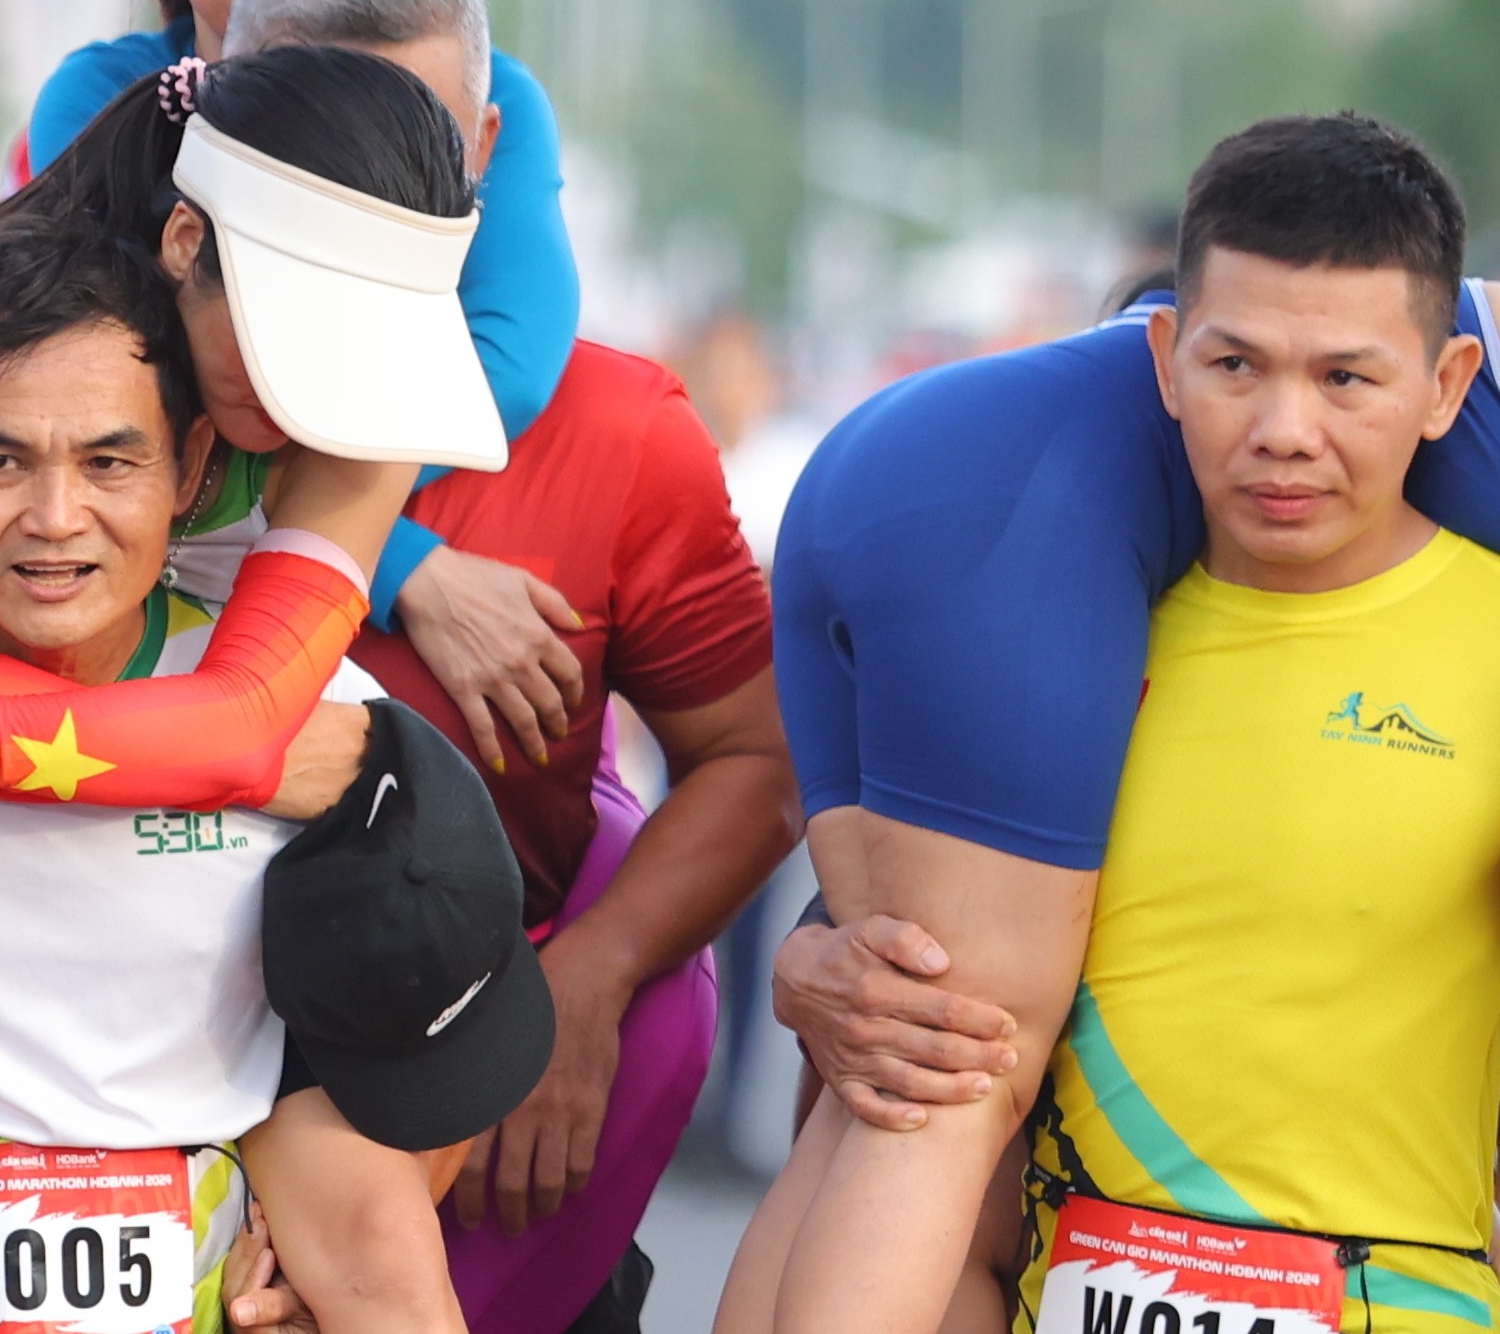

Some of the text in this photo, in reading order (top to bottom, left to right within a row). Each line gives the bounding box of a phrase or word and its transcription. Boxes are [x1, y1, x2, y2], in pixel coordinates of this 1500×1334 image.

[1386, 739, 1456, 760] RUNNERS
[56, 1153, 96, 1165] HDBank
[8, 1177, 85, 1191] MARATHON
[145, 1174, 173, 1186] 2024
[1197, 1235, 1235, 1252] HDBank
[1069, 1230, 1101, 1250] GREEN
[1102, 1238, 1126, 1255] CAN
[1127, 1244, 1147, 1260] GIO
[1149, 1248, 1223, 1274] MARATHON
[1285, 1271, 1320, 1286] 2024
